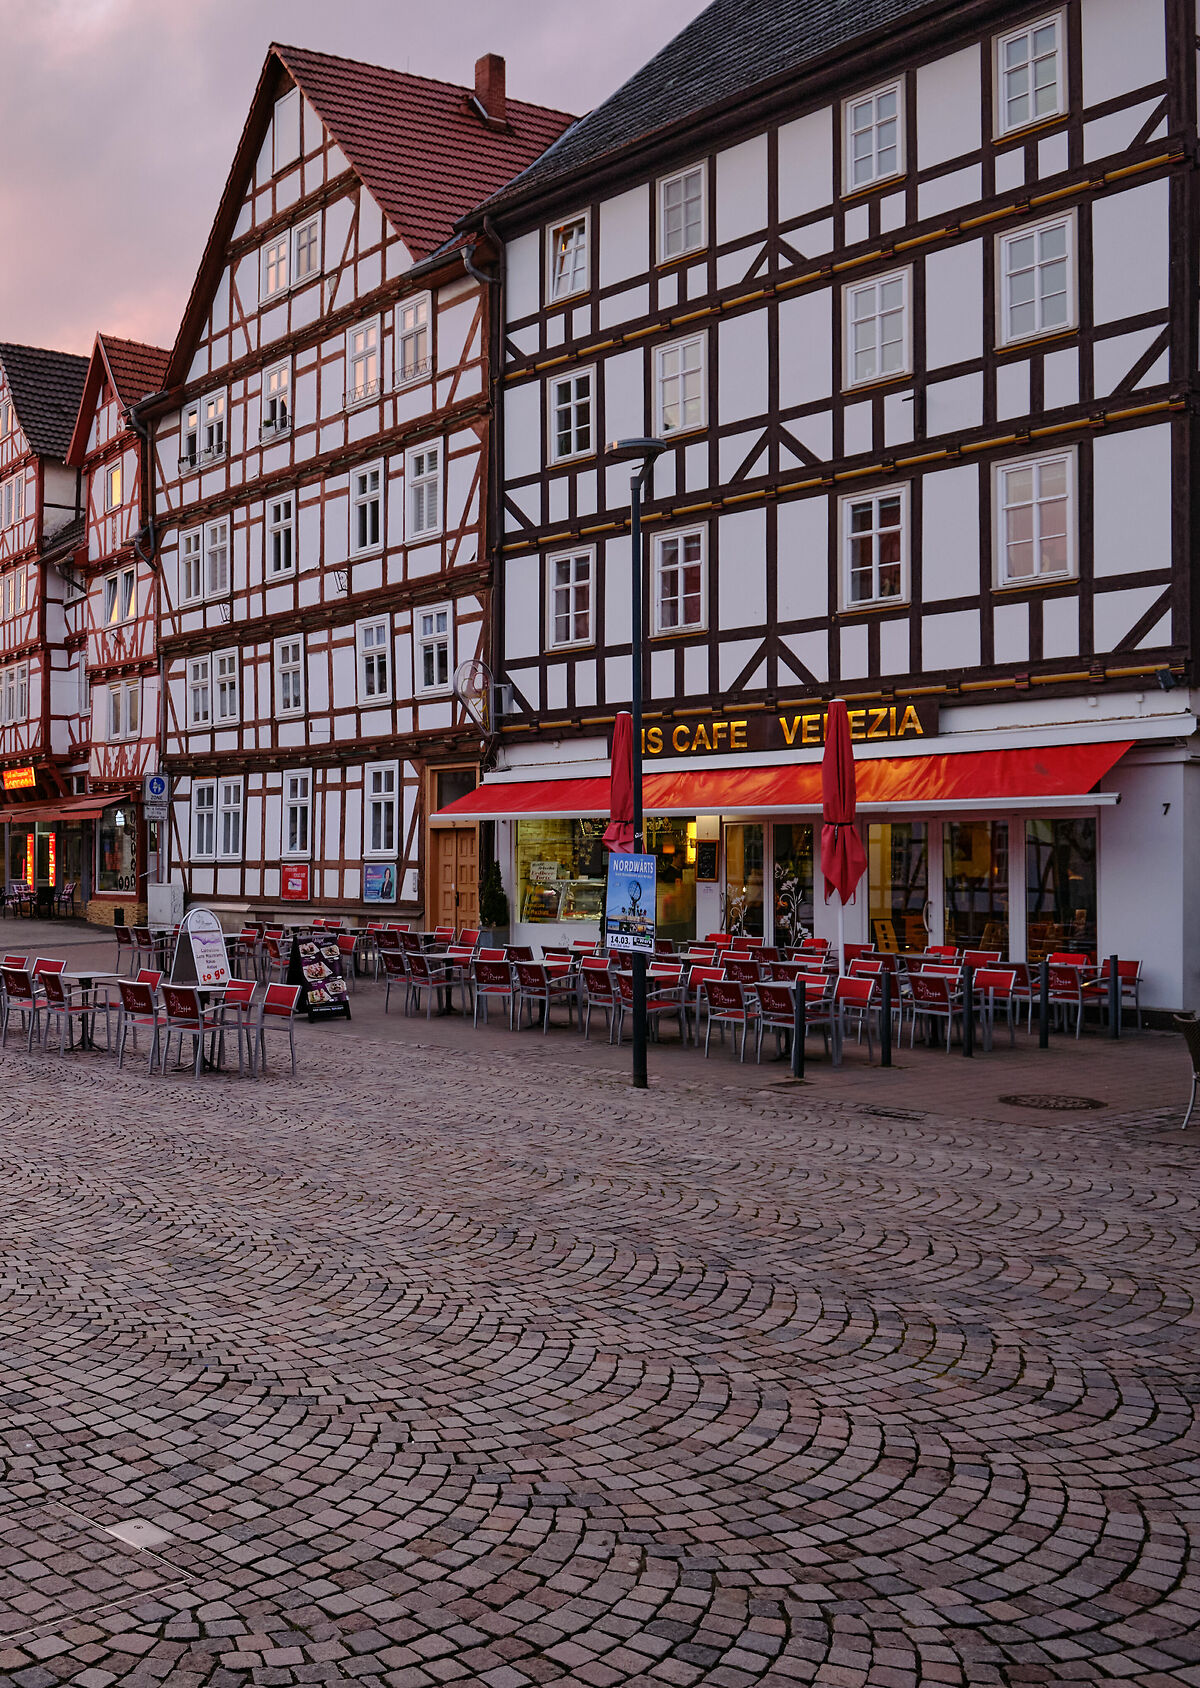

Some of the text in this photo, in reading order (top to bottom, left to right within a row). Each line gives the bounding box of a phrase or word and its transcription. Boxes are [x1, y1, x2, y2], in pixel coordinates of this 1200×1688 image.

[641, 705, 924, 755] IS CAFE VEEZIA
[1162, 802, 1171, 816] 7
[610, 935, 631, 945] 14.03.
[202, 968, 225, 982] to go
